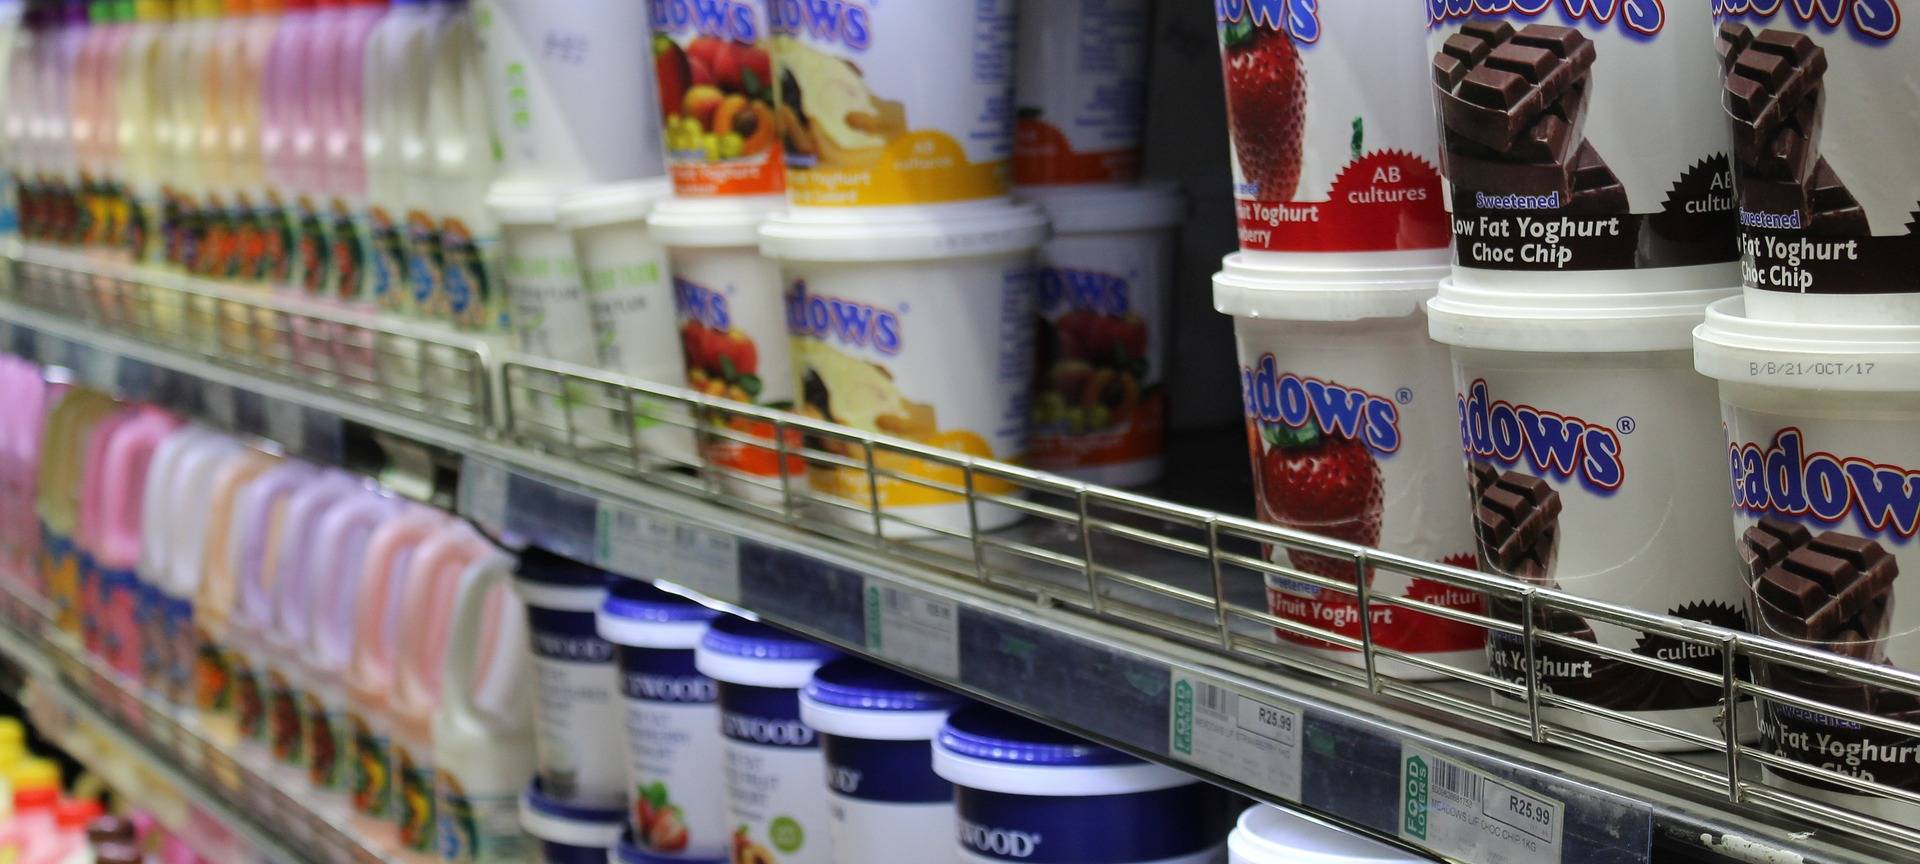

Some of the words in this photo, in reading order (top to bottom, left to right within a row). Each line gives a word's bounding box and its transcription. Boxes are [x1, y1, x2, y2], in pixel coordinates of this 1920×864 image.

[1372, 167, 1401, 183] AB
[1348, 186, 1427, 204] cultures
[1476, 191, 1560, 209] Sweetened
[1252, 203, 1320, 227] Yoghurt
[1739, 206, 1801, 230] Sweetened
[1480, 216, 1510, 238] Fat
[1517, 217, 1620, 244] Yoghurt
[1472, 242, 1515, 263] Choc
[1520, 243, 1573, 269] Chip
[1742, 232, 1762, 257] Fat
[1764, 235, 1858, 267] Yoghurt
[1741, 260, 1766, 285] Choc
[1769, 265, 1814, 294] Chip
[1750, 361, 1876, 376] B/B/21/OCT/17
[1259, 706, 1292, 732] R25.99
[1780, 721, 1810, 752] Fat
[1407, 761, 1419, 833] FOOD
[1417, 767, 1427, 836] LOVER'S
[1509, 794, 1551, 826] R25.99
[1522, 838, 1537, 853] 1KG
